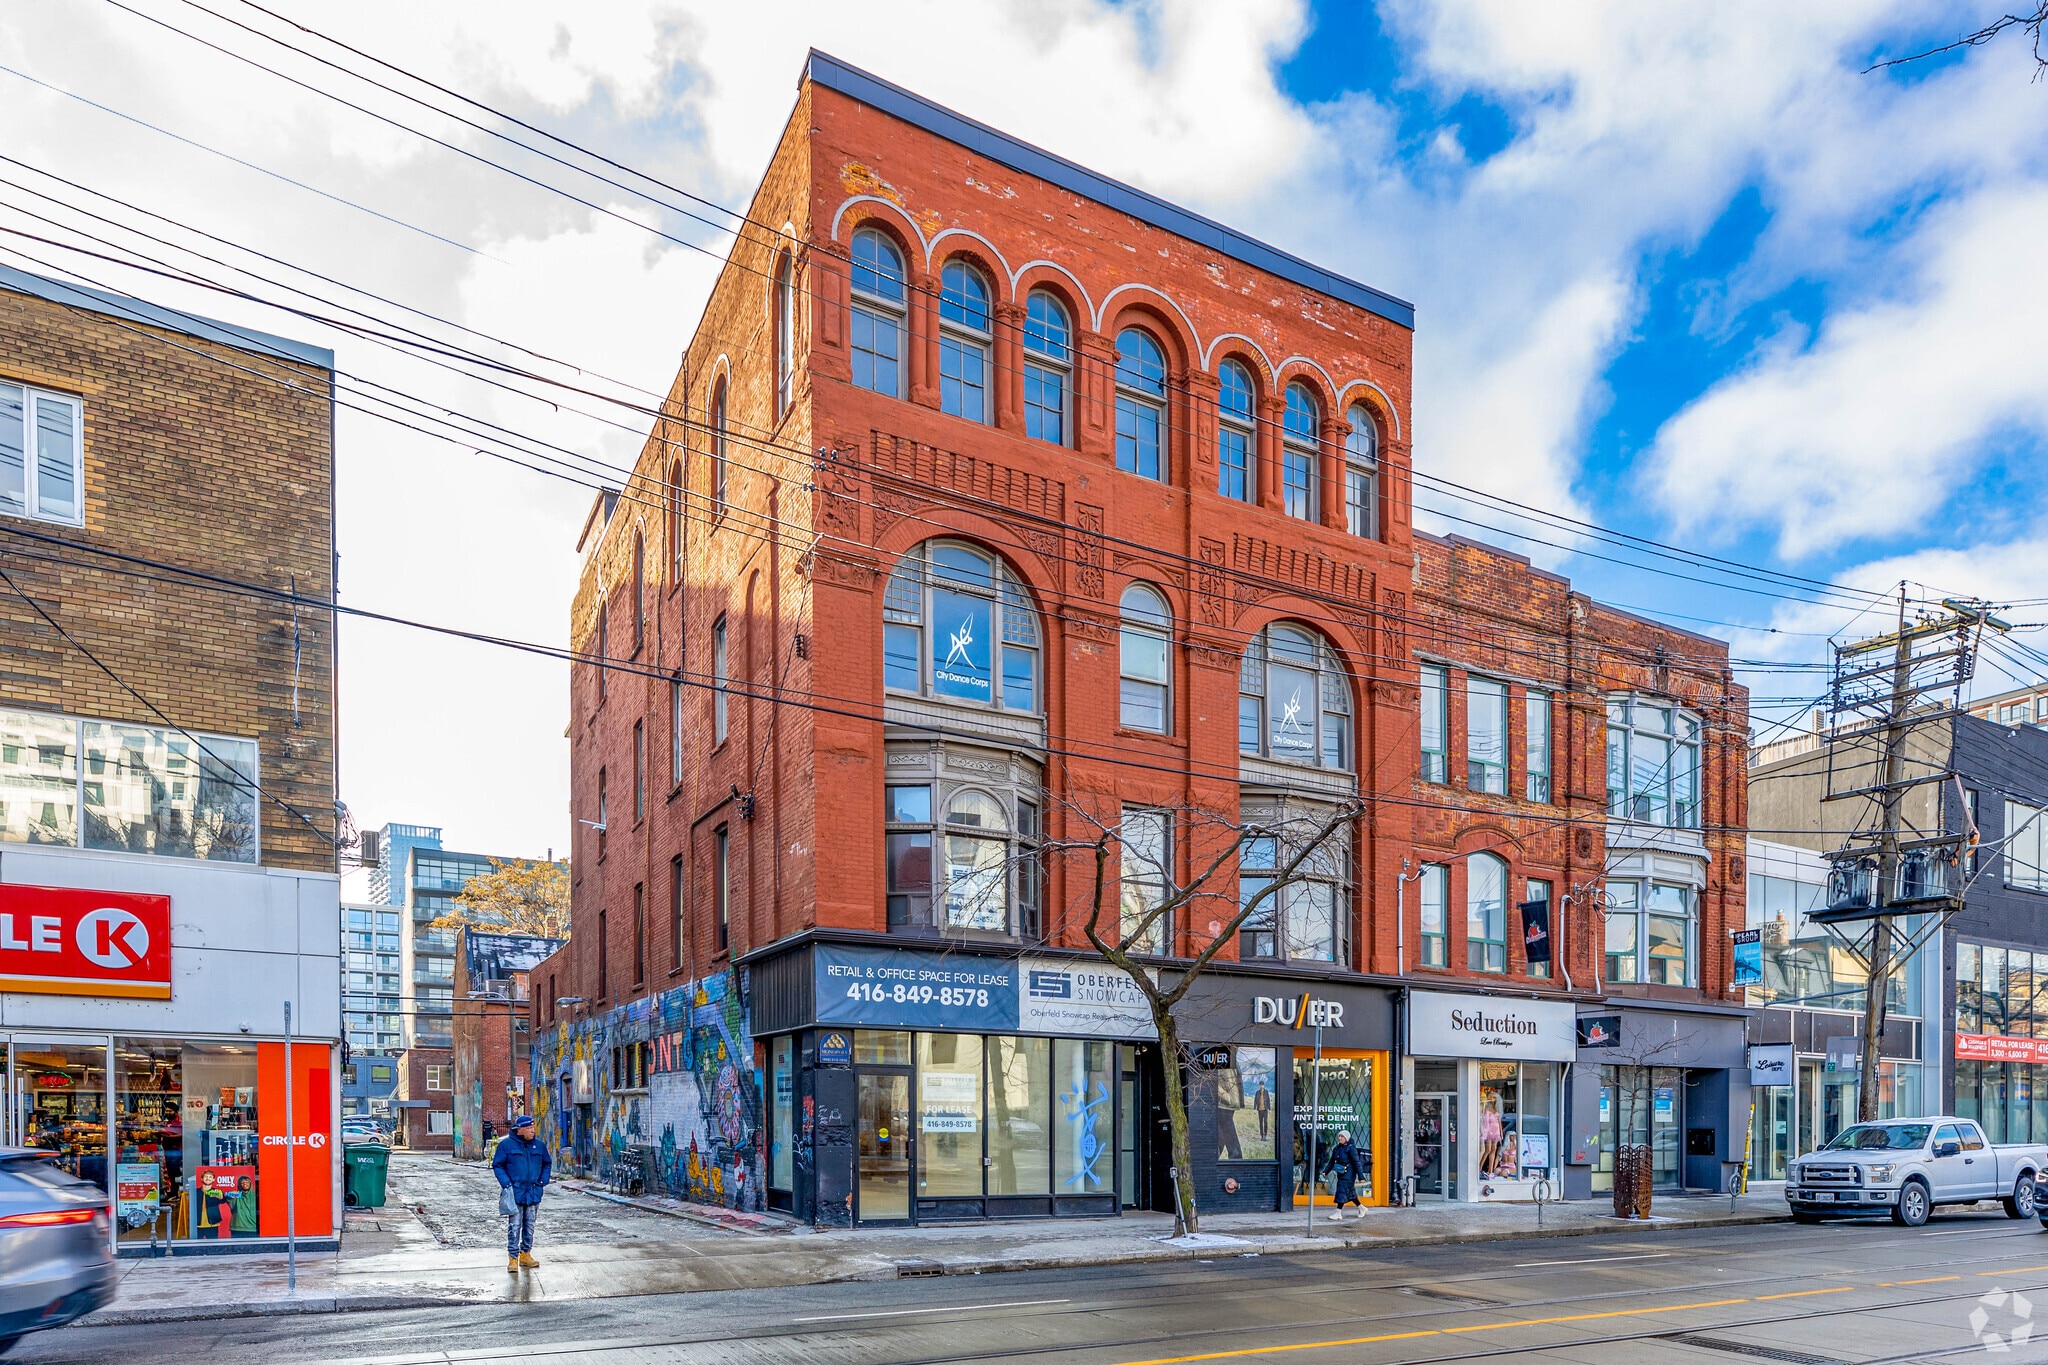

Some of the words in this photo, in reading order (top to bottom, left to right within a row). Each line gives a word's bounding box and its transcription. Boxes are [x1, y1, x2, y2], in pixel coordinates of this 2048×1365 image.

[936, 670, 949, 681] City
[949, 672, 970, 684] Dance
[970, 676, 989, 688] Corps
[94, 918, 143, 966] K
[827, 965, 863, 978] RETAIL
[866, 967, 874, 978] &
[877, 967, 916, 980] OFFICE
[918, 970, 951, 983] SPACE
[954, 972, 975, 984] FOR
[978, 974, 1009, 986] LEASE
[846, 982, 989, 1008] 416-849-8578
[1078, 988, 1145, 1004] SNOWCAP
[1030, 1008, 1060, 1018] Oberfeld
[1062, 1011, 1090, 1021] Snowcap
[1451, 1009, 1538, 1035] Seduction
[1991, 1039, 2007, 1048] RETAIL
[2008, 1041, 2019, 1049] FOR
[1203, 1050, 1229, 1065] DU/ER
[1755, 1059, 1785, 1071] Leisure
[926, 1104, 944, 1114] FOR
[945, 1105, 973, 1114] LEASE
[927, 1120, 973, 1128] 416-849-8578
[1327, 1114, 1359, 1122] DENIM
[217, 1175, 235, 1185] ONLY
